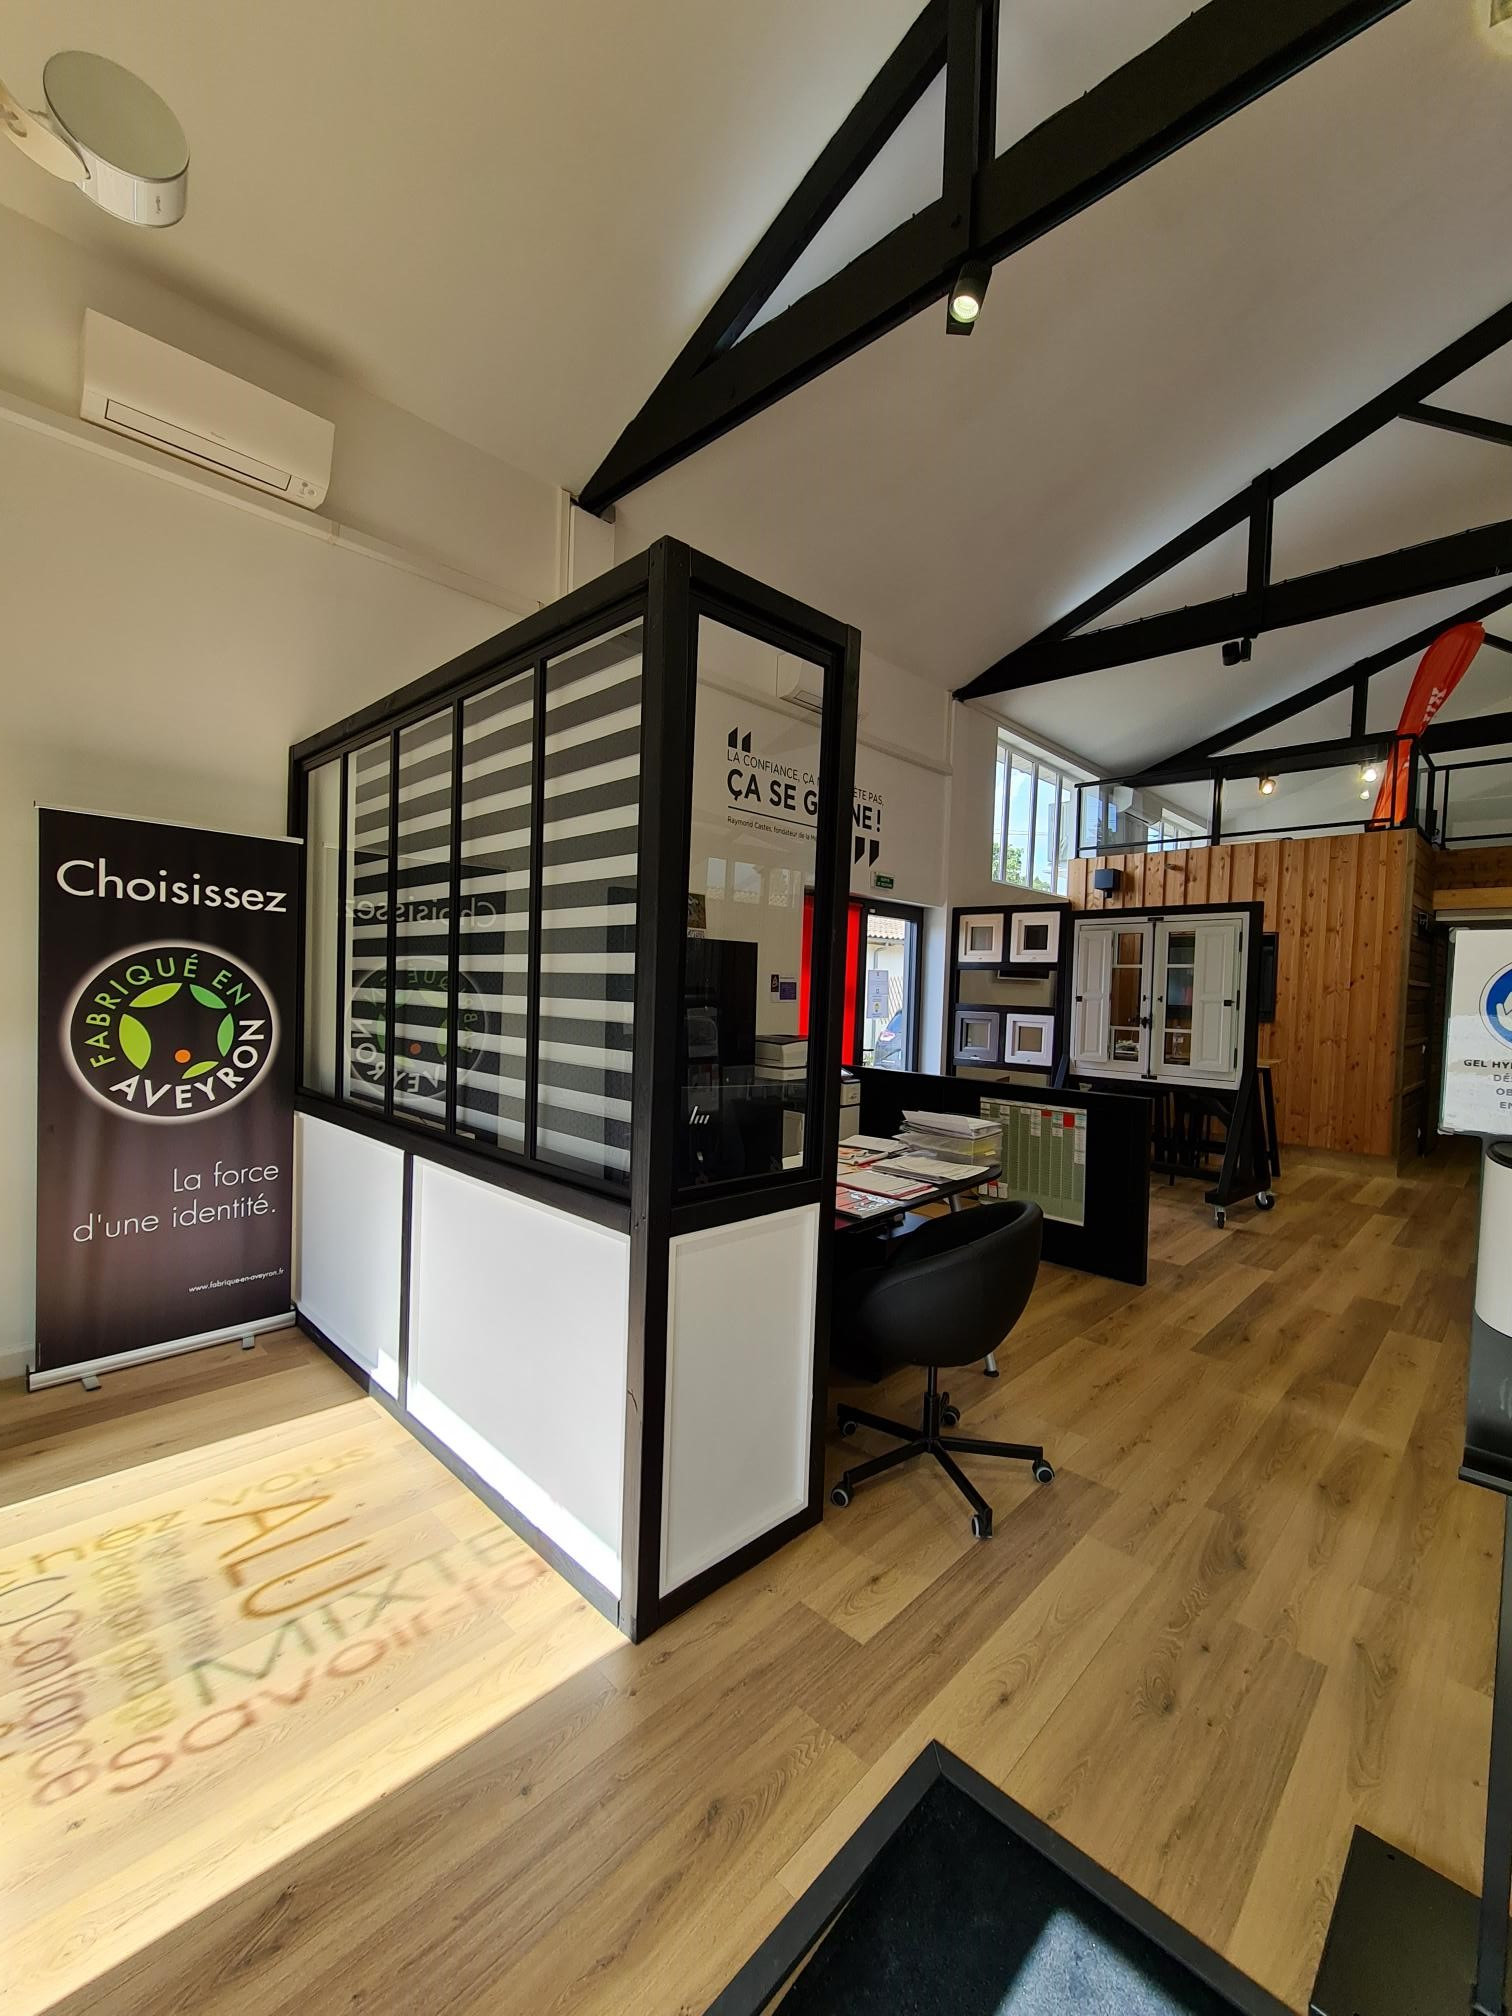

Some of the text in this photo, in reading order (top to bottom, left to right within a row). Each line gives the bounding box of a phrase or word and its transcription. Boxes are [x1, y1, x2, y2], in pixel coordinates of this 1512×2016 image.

[727, 749, 740, 763] LA
[743, 754, 799, 782] CONFIANCE,
[802, 772, 815, 785] ÇA
[727, 768, 761, 802] ÇA
[769, 780, 797, 811] SE
[727, 815, 754, 829] Raymond
[56, 858, 288, 913] Choisissez
[84, 953, 251, 1069] FABRIQUÉ EN
[109, 1018, 266, 1110] AVEYRON
[1464, 1059, 1512, 1069] GEL HY
[1493, 1072, 1512, 1083] DÉ
[173, 1161, 280, 1193] La force
[72, 1191, 277, 1244] d'une identité.
[202, 1494, 391, 1620] ALU
[189, 1523, 530, 1705] MIXTE
